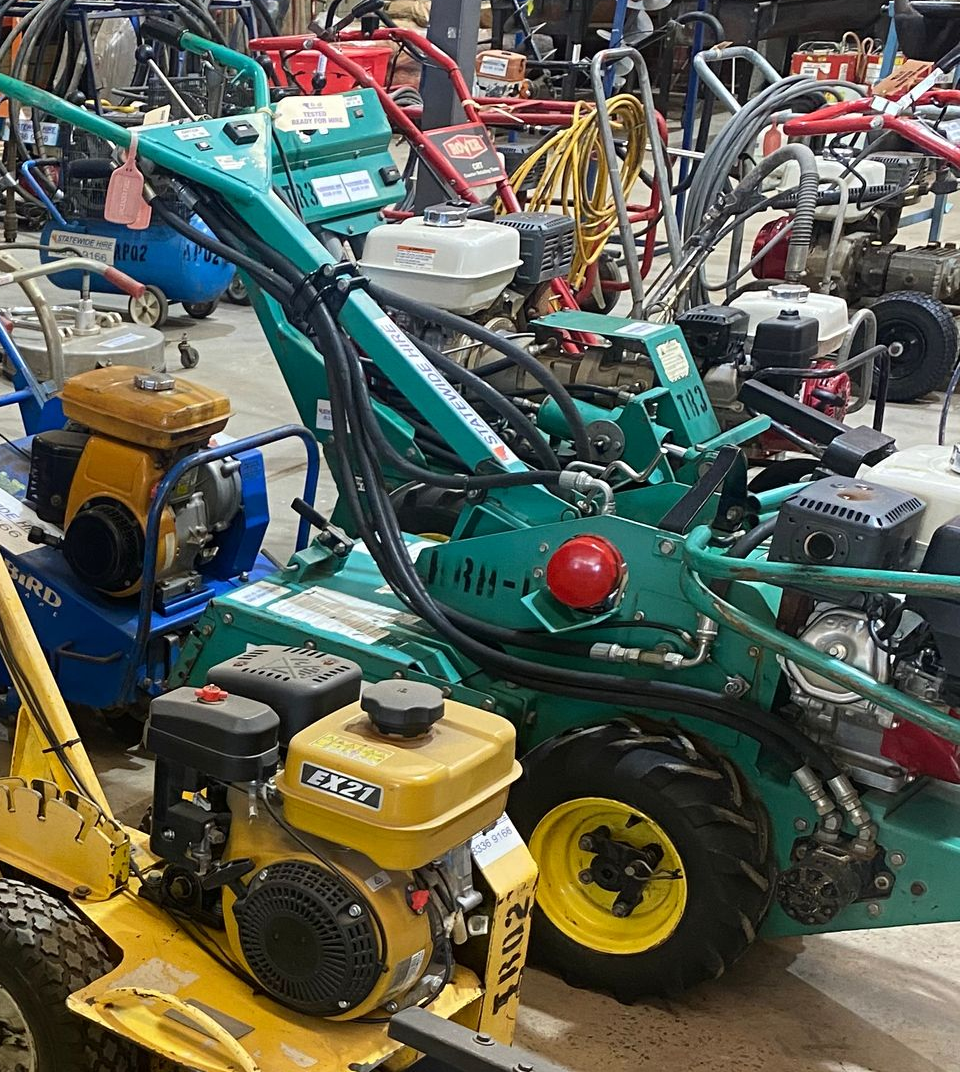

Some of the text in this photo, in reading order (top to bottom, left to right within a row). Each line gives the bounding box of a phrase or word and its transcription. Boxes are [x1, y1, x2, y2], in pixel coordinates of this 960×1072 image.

[291, 118, 313, 126] READY
[314, 117, 327, 125] FOR
[447, 139, 484, 156] ROVER
[57, 235, 113, 250] STATEWIDE HIRE
[380, 324, 419, 359] HIRE
[415, 362, 498, 445] STATEWIDE
[306, 769, 376, 803] EX21
[492, 826, 513, 845] 9166
